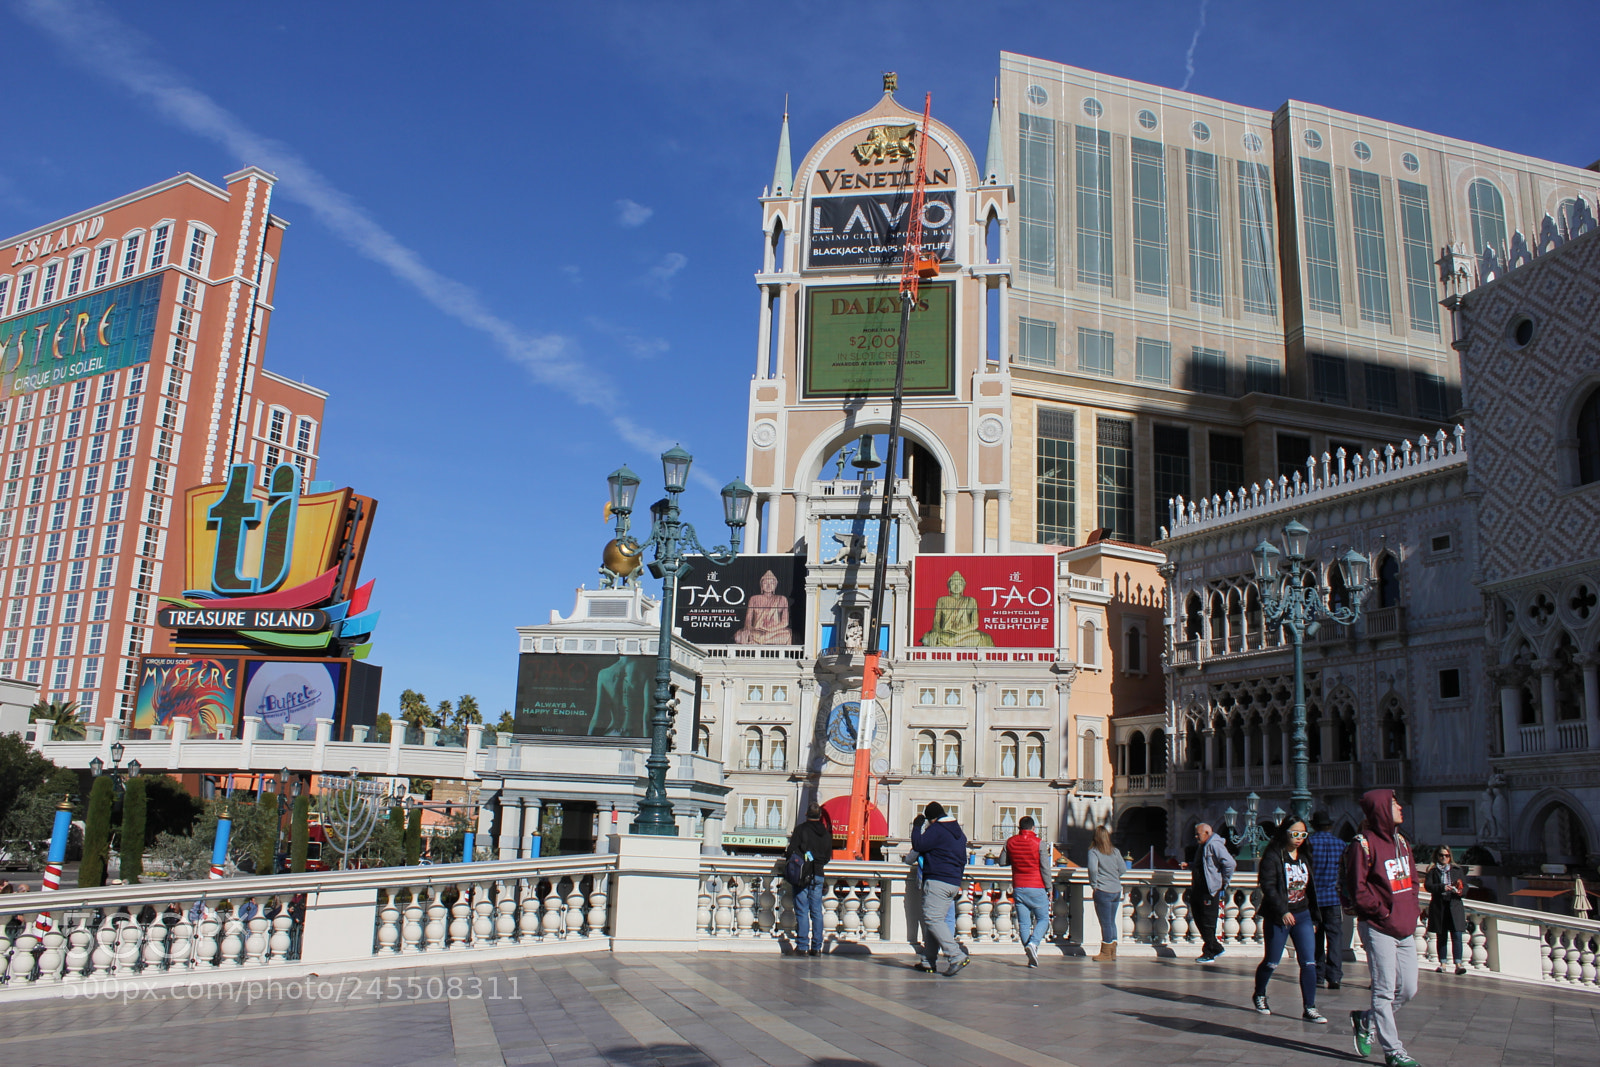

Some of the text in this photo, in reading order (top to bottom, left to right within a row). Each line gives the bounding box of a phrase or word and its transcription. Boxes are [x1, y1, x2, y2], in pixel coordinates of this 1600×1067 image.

[816, 168, 951, 193] VENETIAN
[813, 200, 952, 234] LAVO
[11, 215, 105, 266] ISLAND
[812, 234, 849, 242] CASINO
[813, 247, 864, 257] BLACKJACK
[868, 245, 898, 254] CRAPS
[838, 352, 847, 361] IN
[879, 350, 920, 360] CREITS
[14, 356, 105, 391] CIRQUE DU SOLEIL
[680, 584, 745, 607] TAO
[981, 585, 1051, 608] TAO
[168, 610, 315, 627] TREASURE ISLAND
[142, 664, 234, 689] MYSTÈRE
[265, 685, 310, 723] Buffet
